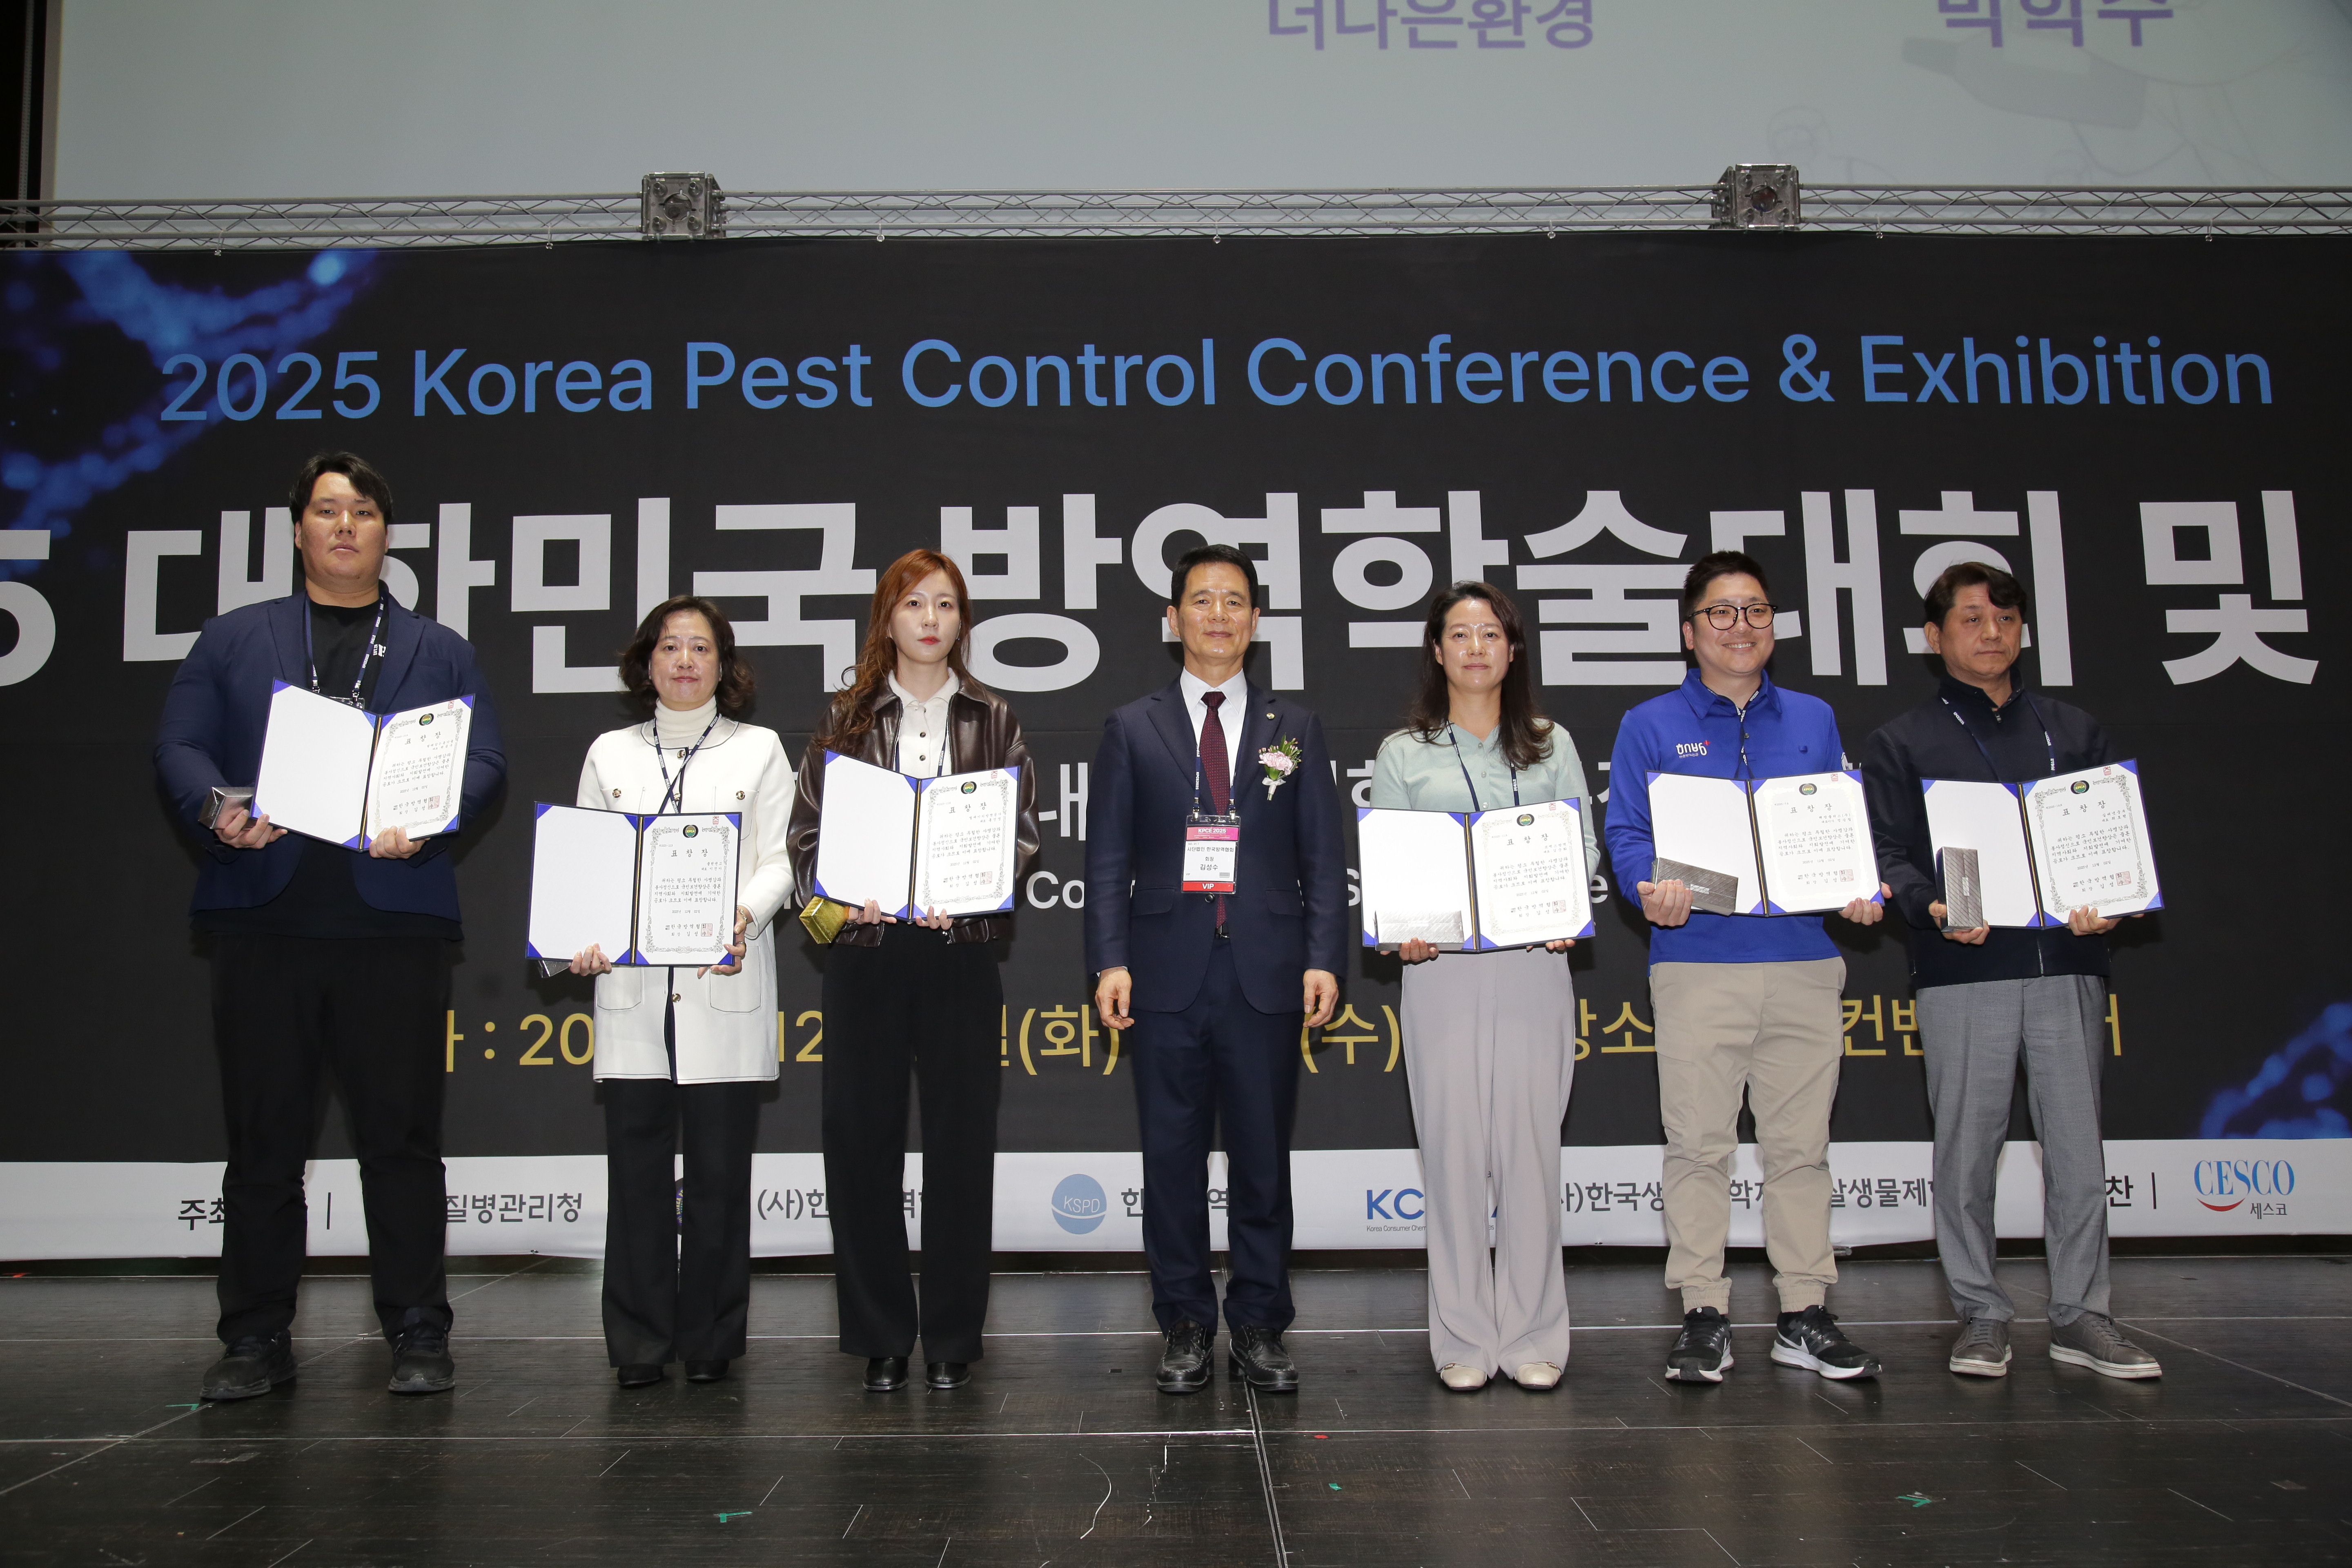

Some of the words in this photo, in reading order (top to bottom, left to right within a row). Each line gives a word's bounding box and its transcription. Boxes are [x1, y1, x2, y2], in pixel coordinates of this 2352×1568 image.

[160, 351, 381, 421] 2025
[414, 348, 652, 416] Korea
[687, 342, 873, 409] Pest
[902, 338, 1216, 408] Control
[1247, 334, 1749, 406] Conference
[1779, 334, 1835, 402] &
[1861, 335, 2273, 404] Exhibition
[2139, 490, 2319, 685] 및
[2061, 800, 2106, 815] 표창장
[671, 849, 708, 857] 표창장
[1001, 1004, 1120, 1075] (화)
[2105, 1175, 2134, 1207] 찬
[2194, 1160, 2295, 1196] CESCO
[447, 1193, 582, 1223] 질병관리청
[1063, 1196, 1100, 1213] KSPD
[2250, 1202, 2288, 1220] 세스코
